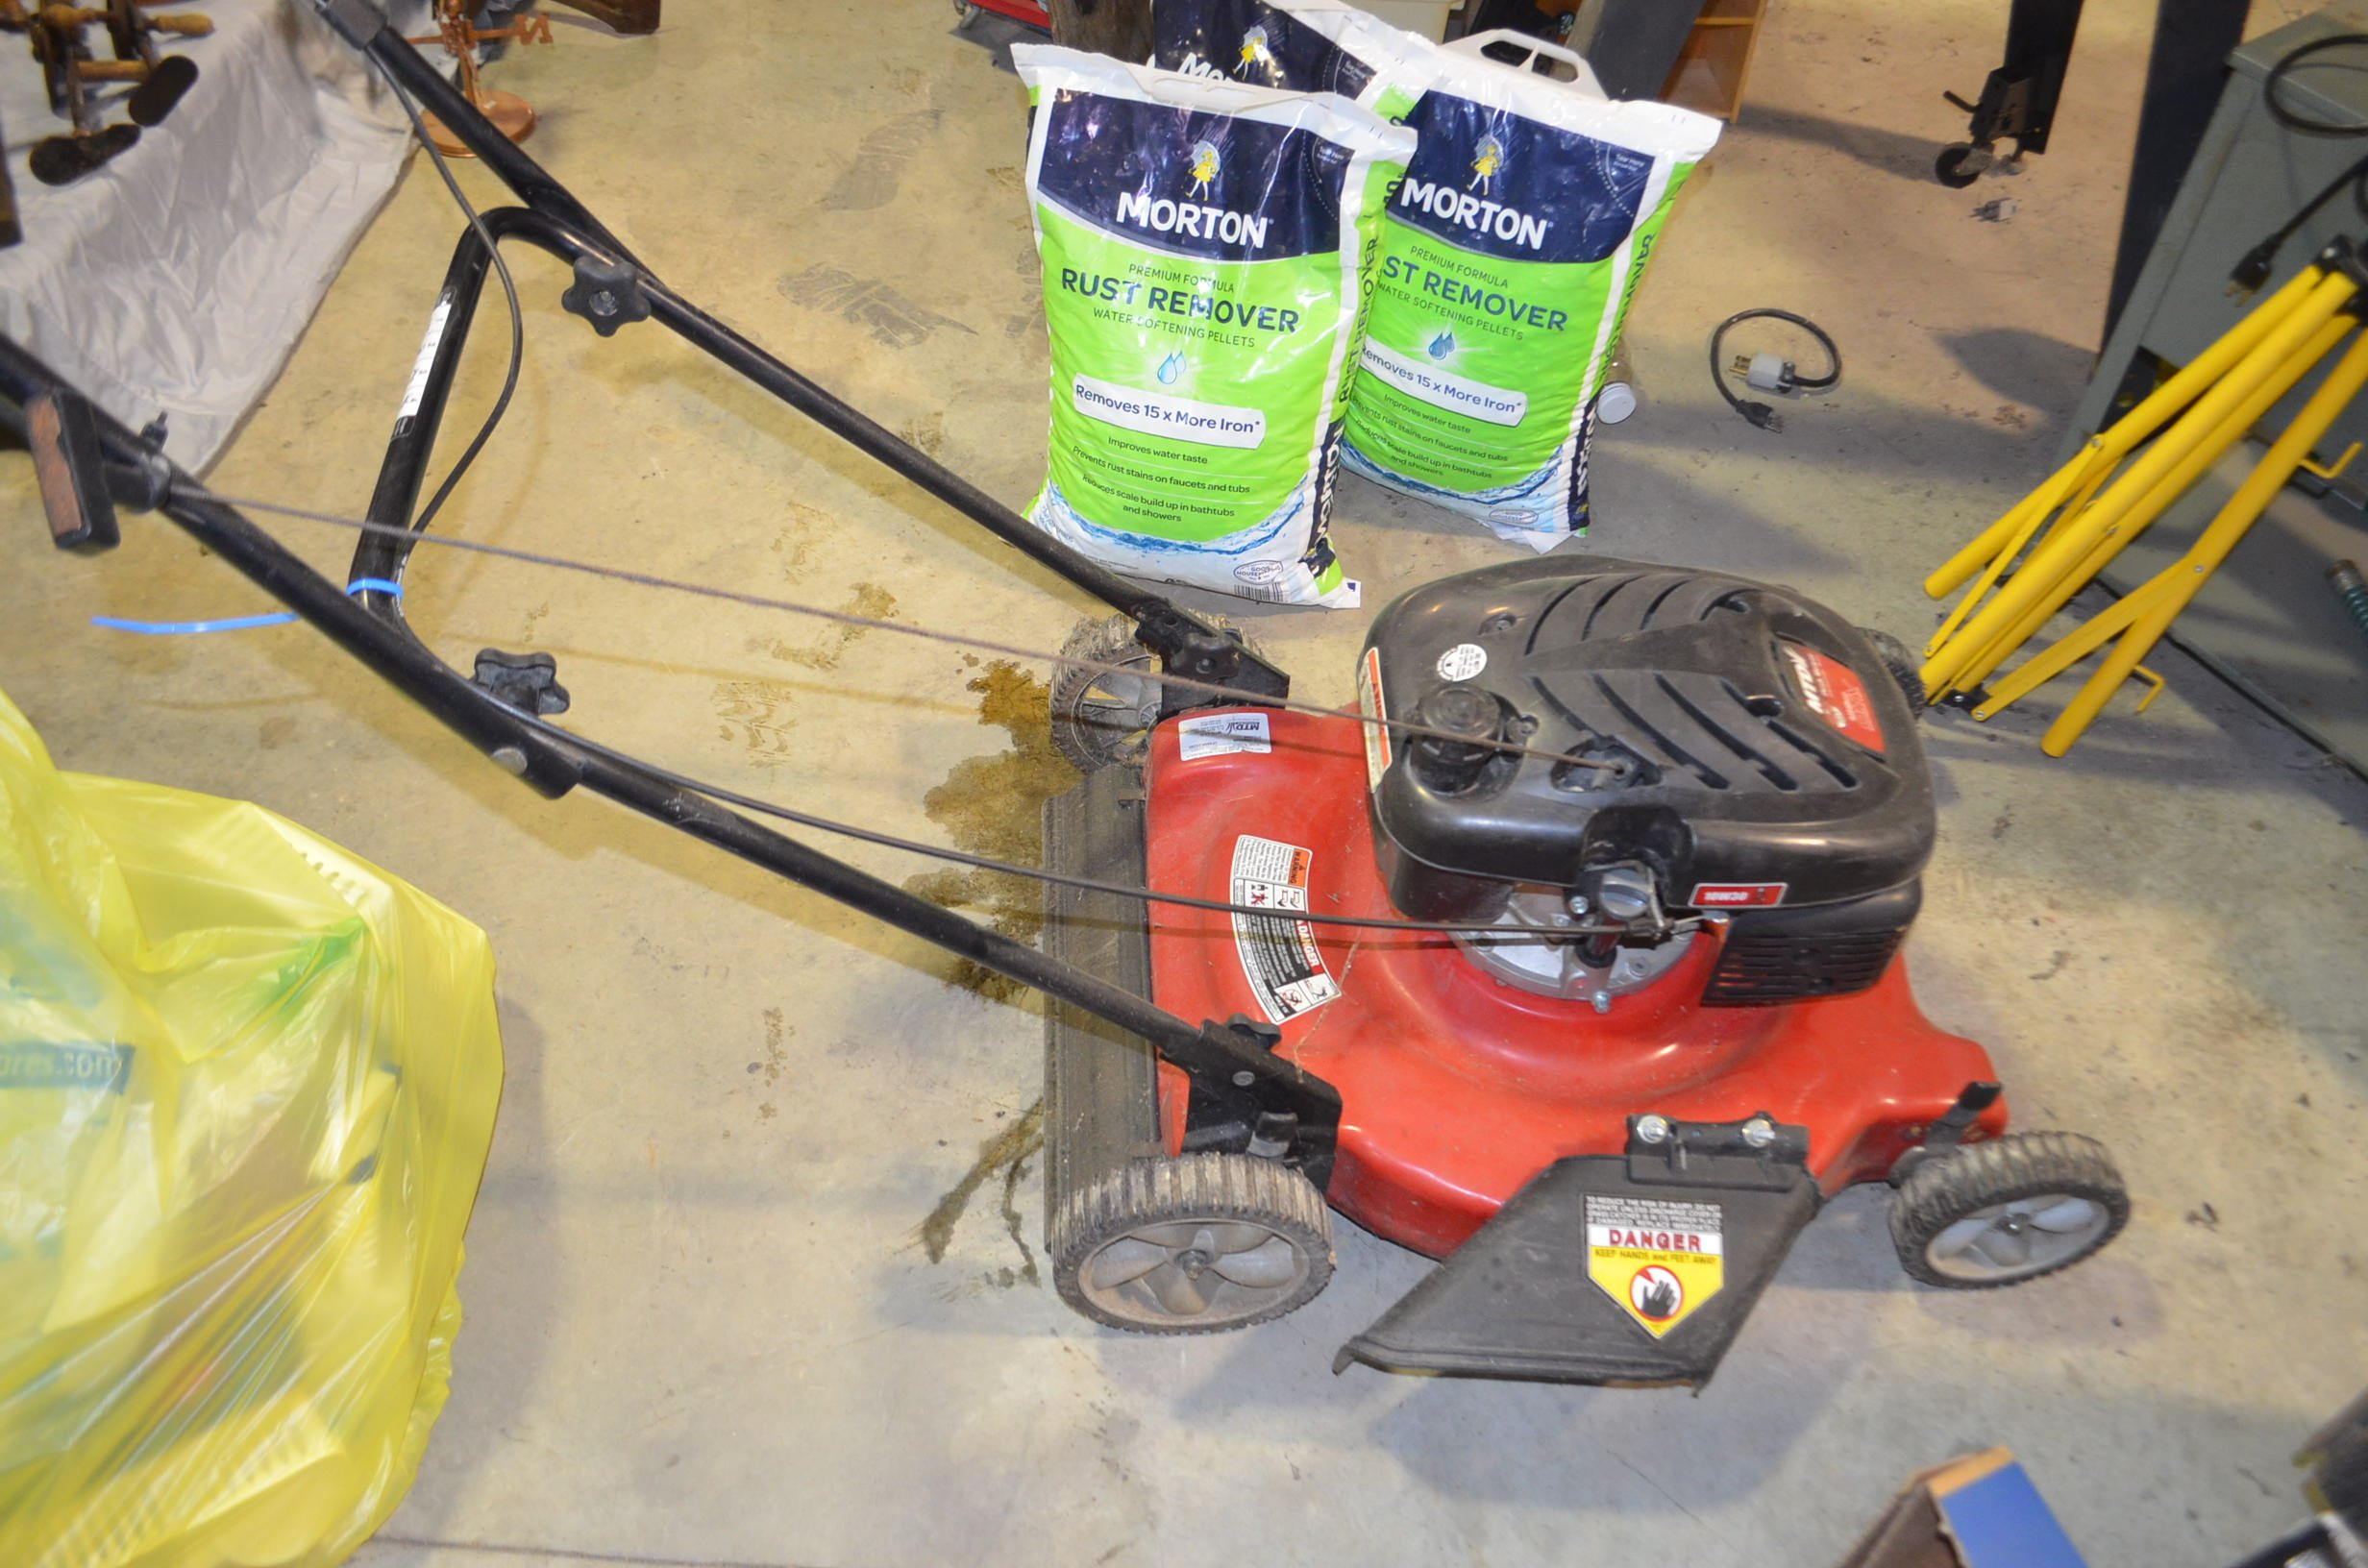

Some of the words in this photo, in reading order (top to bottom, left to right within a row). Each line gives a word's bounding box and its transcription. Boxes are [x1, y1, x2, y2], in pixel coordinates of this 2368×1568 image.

[1116, 191, 1269, 249] MORTON
[1400, 177, 1547, 251] MORTON
[1128, 263, 1181, 283] PREMIUM
[1183, 274, 1234, 293] FORMULA
[1410, 245, 1455, 271] PREMIUM
[1456, 263, 1508, 288] FORMULA
[1062, 268, 1142, 305] RUST
[1147, 286, 1299, 332] REMOVER
[1377, 282, 1411, 303] WATER
[1414, 294, 1473, 326] SOFTENING
[1475, 319, 1523, 340] PELLETS
[1382, 255, 1419, 285] ST
[1422, 271, 1568, 331] REMOVER
[1093, 307, 1133, 324] WATER
[1136, 316, 1205, 338] SOFTENING
[1207, 331, 1255, 348] PELLETS
[1075, 384, 1140, 415] Removes
[1144, 404, 1160, 418] 15
[1163, 411, 1172, 421] x
[1175, 410, 1217, 429] More
[1416, 374, 1431, 388] 15
[1433, 382, 1442, 392] x
[1443, 384, 1481, 404] More
[1384, 394, 1421, 418] Improves
[1421, 412, 1447, 427] water
[1447, 421, 1471, 433] taste
[1108, 437, 1151, 454] Improves
[1152, 449, 1180, 460] water
[1182, 453, 1208, 464] taste
[1382, 414, 1397, 429] rust
[1397, 423, 1422, 440] stains
[1422, 433, 1434, 444] on
[1435, 436, 1468, 454] faucets
[1468, 448, 1486, 459] and
[1487, 451, 1508, 462] tubs
[1073, 445, 1106, 468] Prevents
[1107, 462, 1124, 474] rust
[1125, 466, 1153, 481] stains
[1155, 475, 1168, 484] on
[1170, 476, 1206, 491] faucets
[1207, 481, 1226, 492] and
[1228, 483, 1250, 494] tubs
[1407, 448, 1429, 464] build
[1430, 456, 1442, 468] up
[1443, 460, 1452, 470] in
[1452, 463, 1492, 479] bathtubs
[1116, 487, 1140, 502] scale
[1140, 493, 1164, 508] build
[1166, 502, 1178, 513] up
[1180, 502, 1189, 511] in
[1190, 503, 1235, 517] bathtubs
[1122, 504, 1141, 515] and
[1142, 507, 1182, 523] showers
[1298, 924, 1320, 968] DANGER
[1595, 1248, 1616, 1257] KEEP
[1619, 1250, 1650, 1261] HANDS
[1670, 1254, 1690, 1263] FEET
[1692, 1256, 1717, 1264] AWAY
[1609, 1229, 1702, 1251] DANGER
